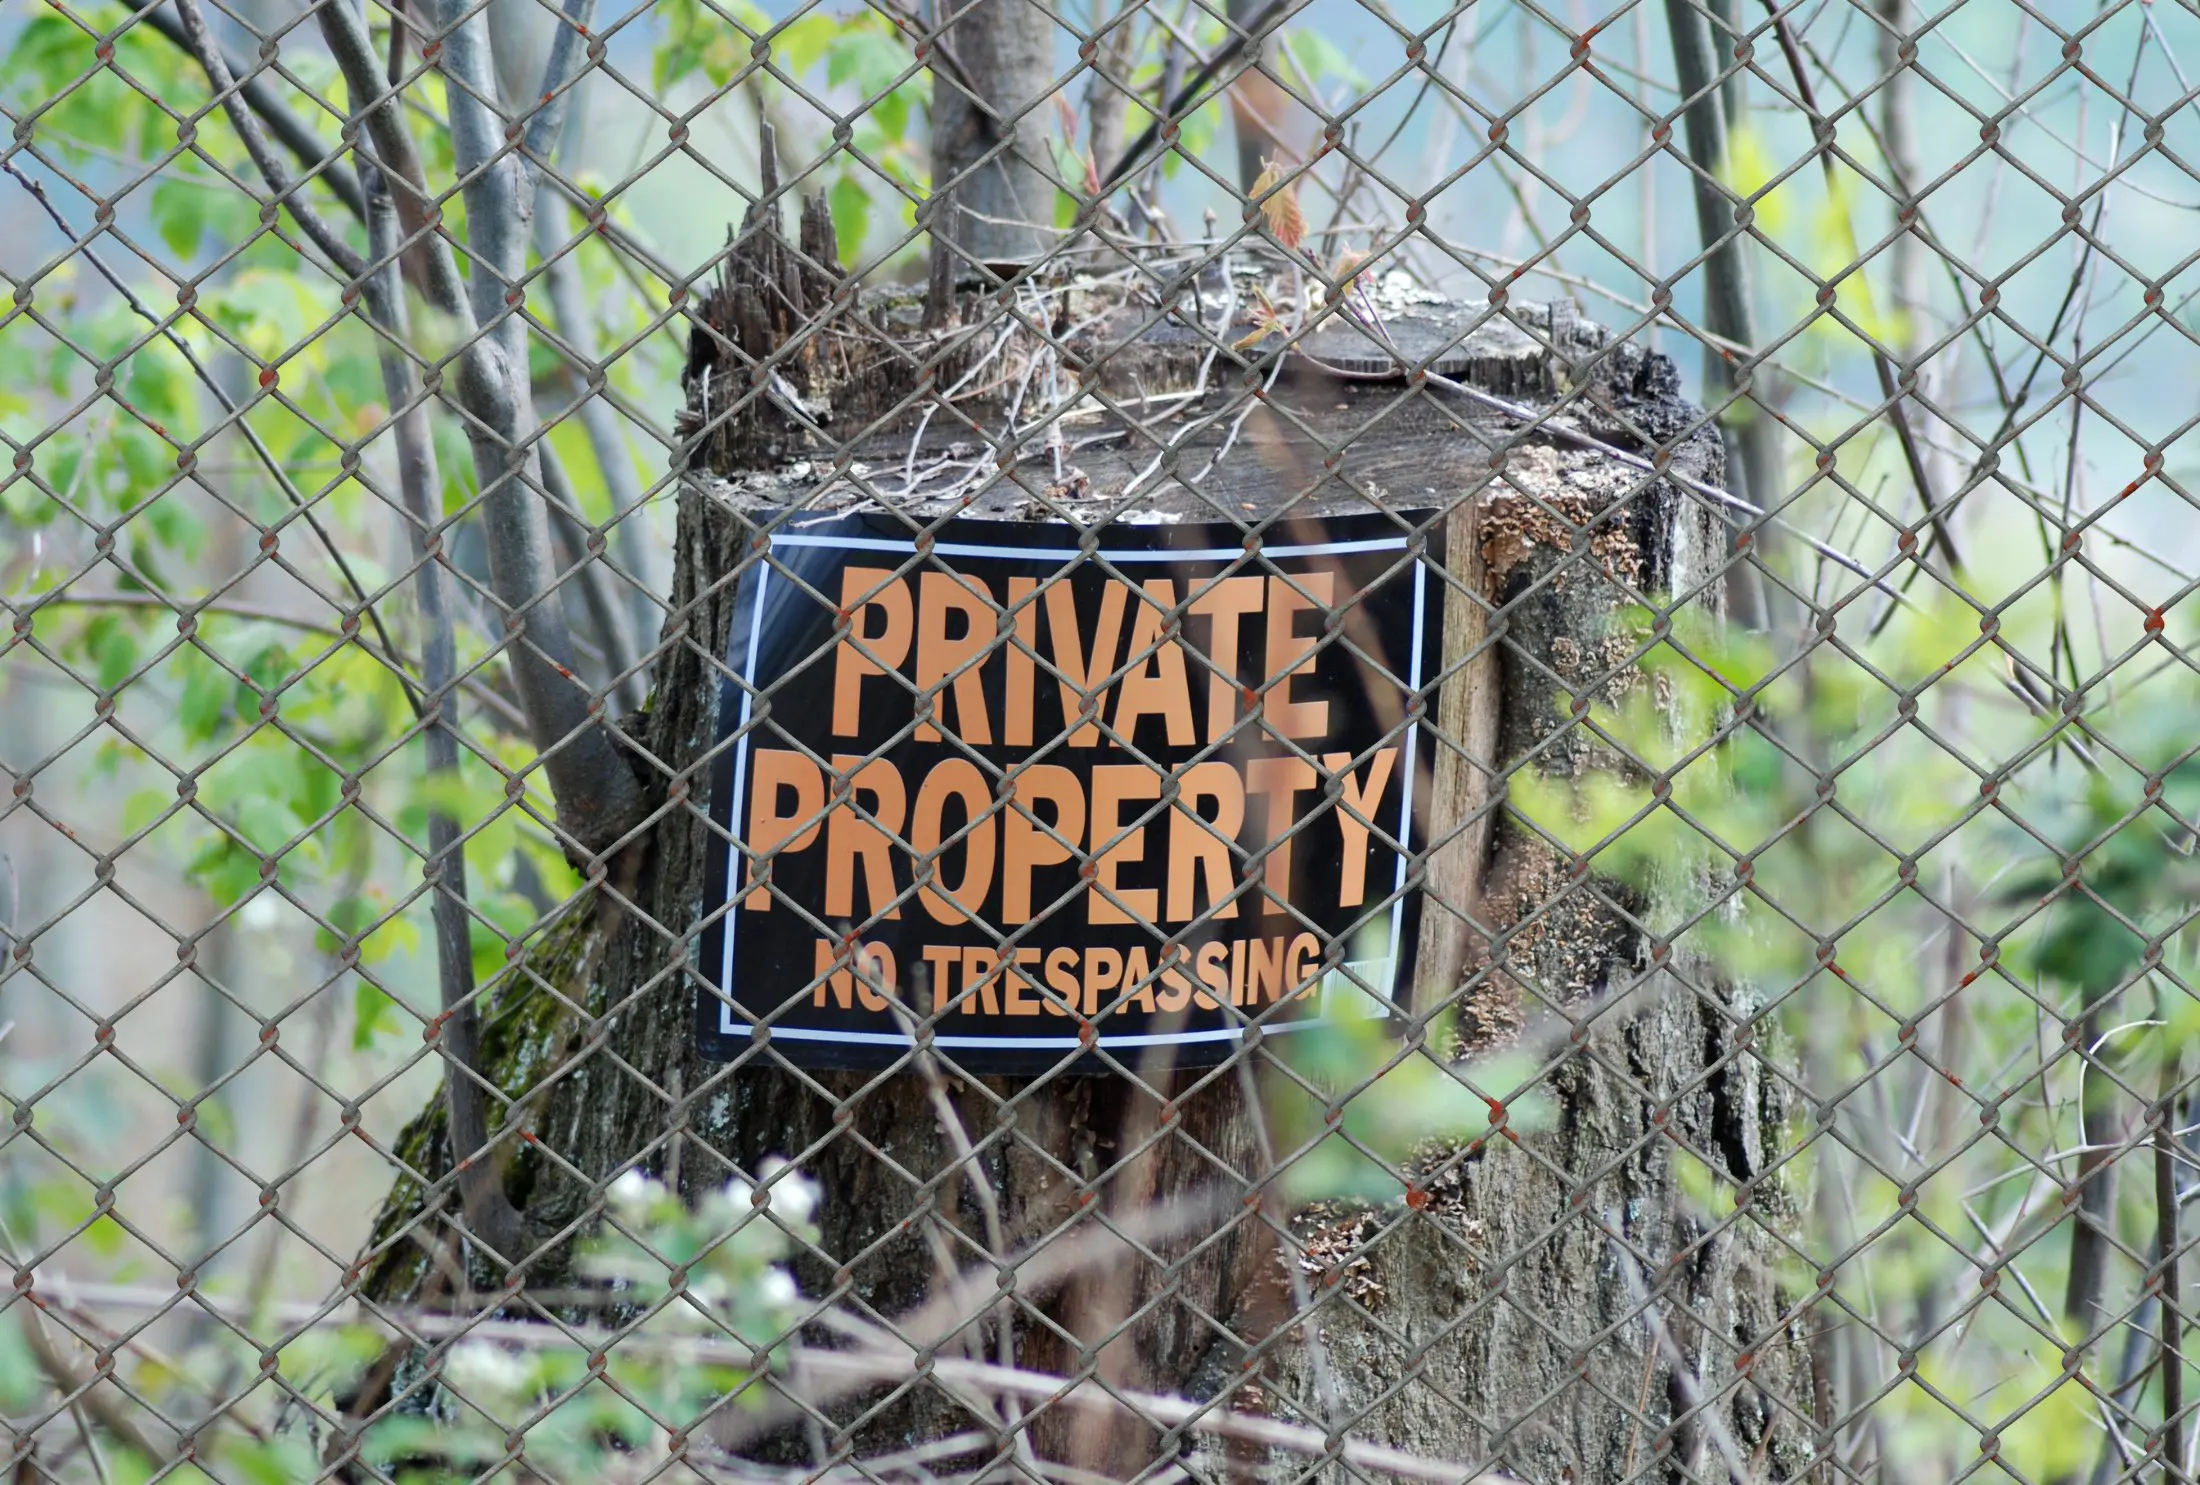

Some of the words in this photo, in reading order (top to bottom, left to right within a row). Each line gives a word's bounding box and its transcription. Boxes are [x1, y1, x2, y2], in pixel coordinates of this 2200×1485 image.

[832, 566, 1335, 748] PRIVATE
[745, 747, 1398, 926] PROPERTY
[813, 938, 896, 1012] NO
[923, 932, 1321, 1016] TRESPASSING
